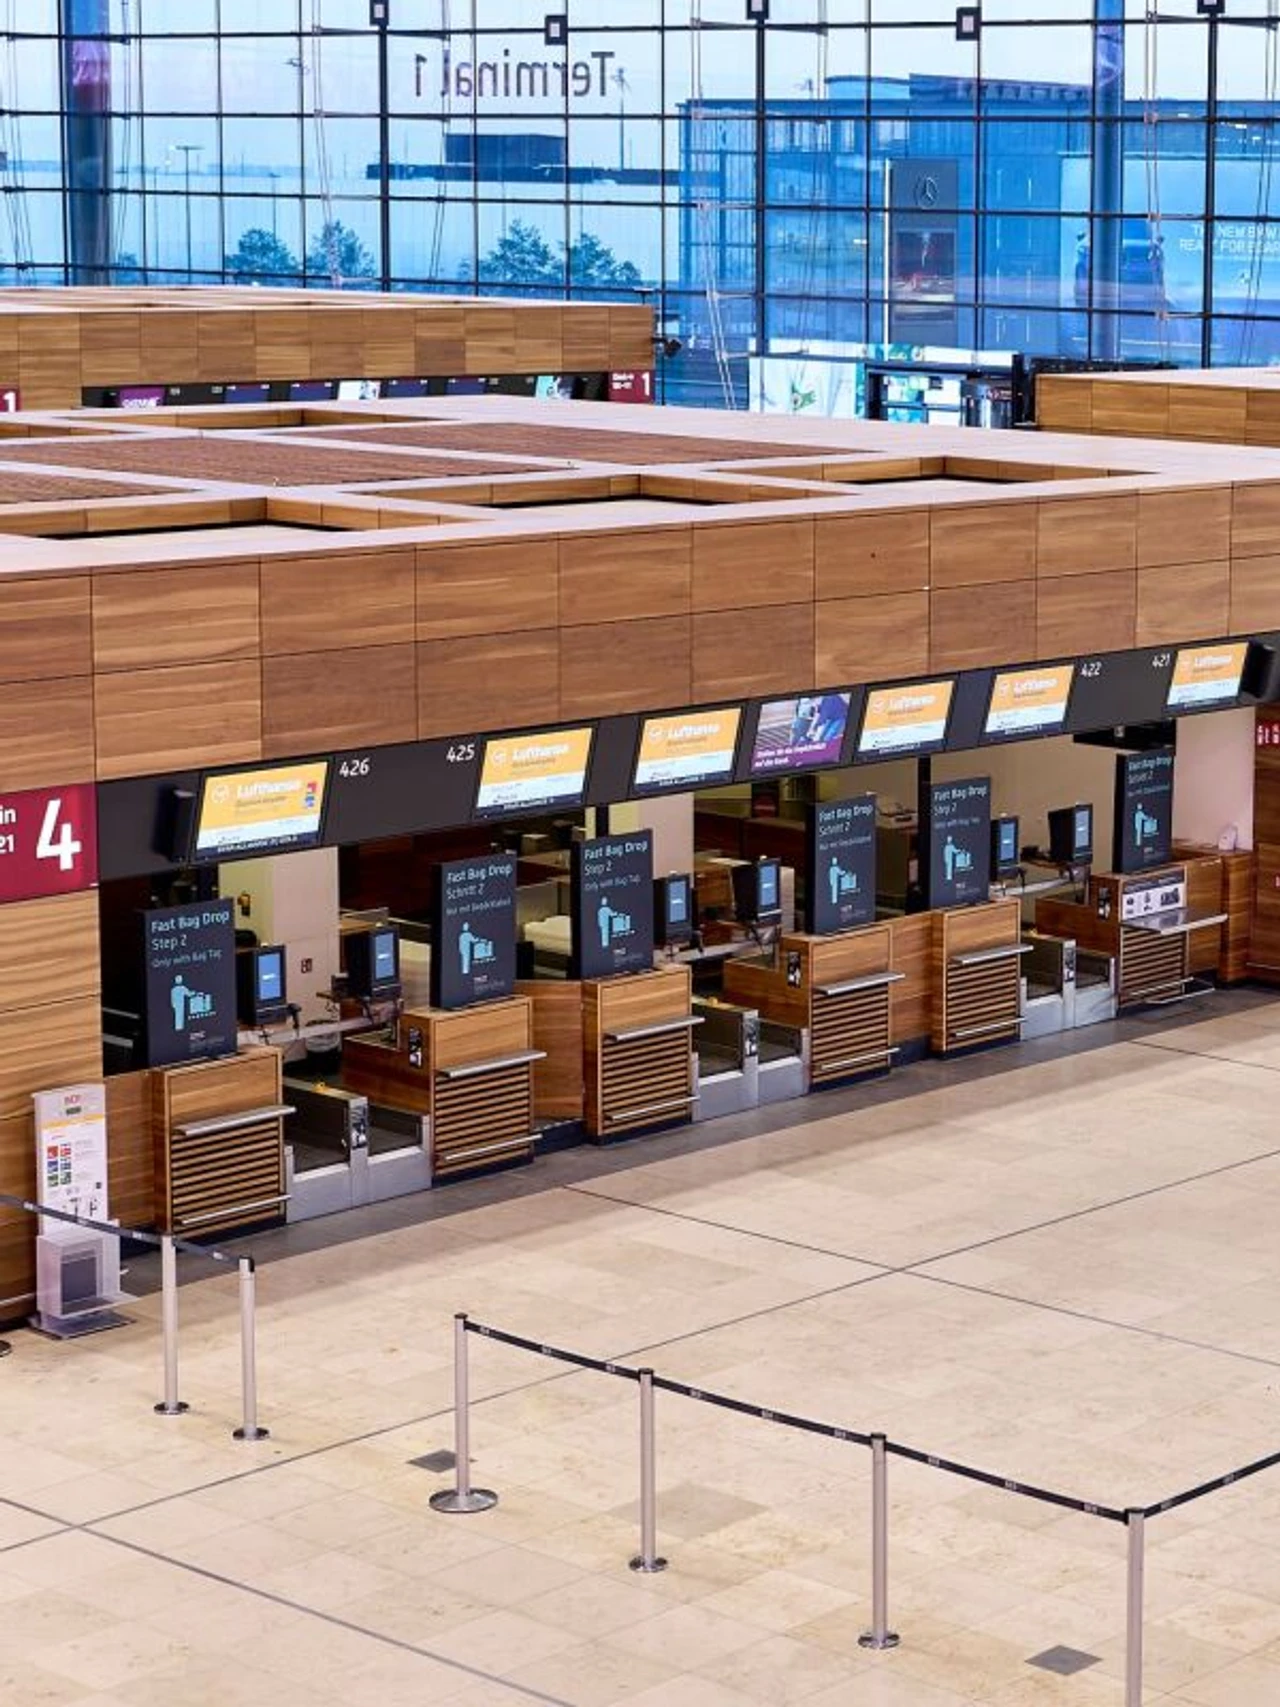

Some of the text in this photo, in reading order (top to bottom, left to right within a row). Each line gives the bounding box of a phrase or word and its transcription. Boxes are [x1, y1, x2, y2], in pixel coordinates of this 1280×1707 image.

[642, 372, 651, 397] 1
[1080, 661, 1102, 678] 422
[445, 743, 476, 763] 425
[339, 758, 371, 778] 426
[36, 799, 82, 873] 4
[584, 841, 649, 861] Fast Bag Drop
[447, 864, 514, 884] Fast Bag Drop
[151, 910, 230, 933] Fast Bag Drop
[151, 937, 179, 951] Step
